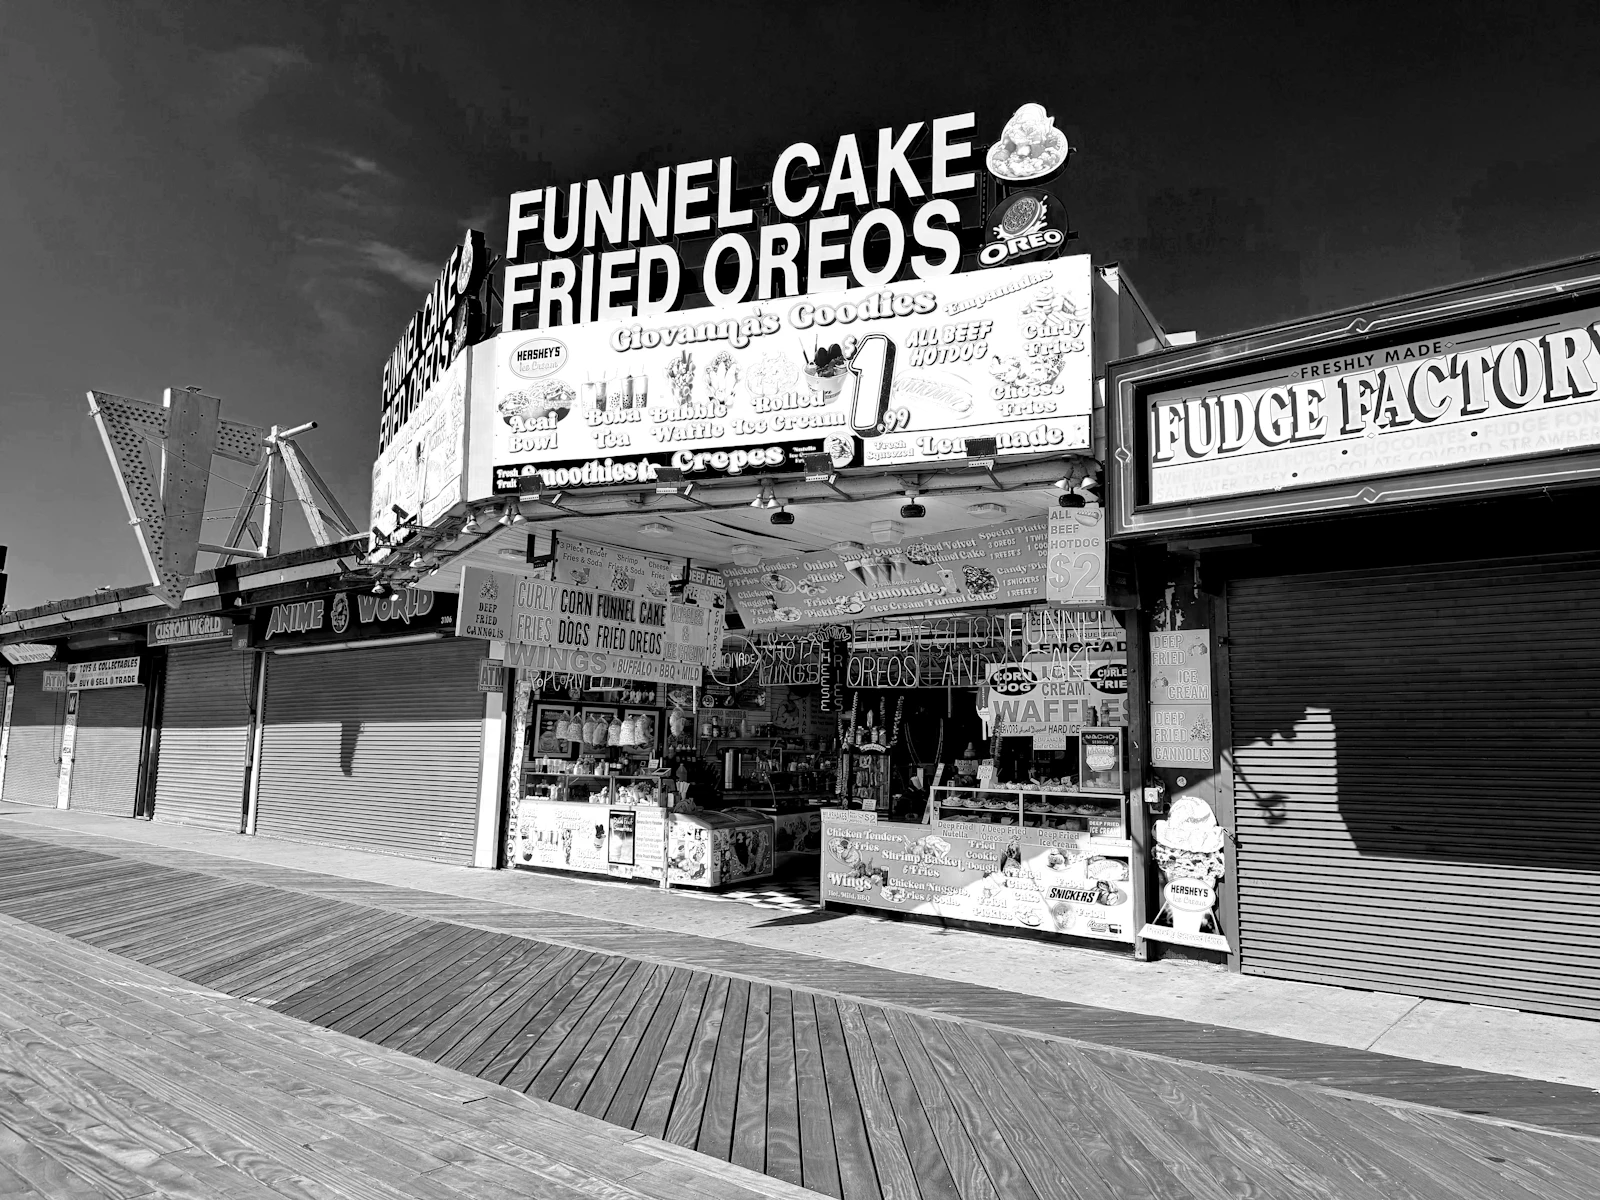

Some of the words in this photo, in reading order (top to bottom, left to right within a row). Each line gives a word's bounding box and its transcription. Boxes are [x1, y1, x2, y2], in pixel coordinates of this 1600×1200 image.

[506, 155, 754, 258] FUNNEL
[771, 112, 975, 218] CAKE
[978, 229, 1063, 267] OREO
[502, 244, 681, 332] FRIED
[702, 199, 961, 307] OREOS
[421, 245, 458, 351] CAKE
[944, 269, 1053, 317] Empanadas
[610, 306, 781, 353] Giovanna's
[788, 290, 938, 330] Goodies
[906, 327, 940, 349] ALL
[941, 319, 993, 344] BEEF
[1021, 320, 1086, 340] Curly
[516, 345, 562, 362] HERSHEY'S
[909, 341, 989, 368] HOTDOG
[1022, 337, 1086, 358] Fries
[1301, 354, 1375, 379] FRESHLY
[1385, 341, 1443, 364] MADE
[989, 380, 1065, 402] Cheese
[1152, 380, 1329, 464] FUDGE
[1340, 320, 1600, 436] FACTOR
[751, 389, 826, 415] Rolled
[998, 399, 1058, 419] Fries
[584, 408, 642, 427] Boba
[650, 402, 728, 424] Bubble
[509, 411, 559, 435] Acai
[731, 416, 769, 436] Ice
[769, 411, 847, 433] Cream
[1484, 414, 1549, 439] FUDGE
[592, 429, 632, 451] Tea
[650, 421, 726, 443] Waffle
[508, 432, 559, 454] Bowl
[915, 425, 1065, 456] Lemnade
[671, 446, 786, 475] Crepes
[1050, 510, 1072, 520] ALL
[978, 527, 1015, 541] Special
[1050, 523, 1080, 535] BEEF
[565, 543, 584, 553] Piece
[585, 546, 608, 558] Tender
[943, 537, 977, 551] Velvet
[993, 538, 1016, 549] OREOS
[1050, 537, 1100, 549] HOTDOG
[562, 552, 579, 562] Fries
[586, 557, 603, 567] Soda
[616, 553, 639, 566] Shrimp
[958, 548, 987, 560] Cake
[607, 562, 622, 571] Fries
[630, 566, 645, 576] Soda
[648, 560, 670, 571] Cheese
[722, 567, 759, 578] Chicken
[758, 561, 798, 574] Tenders
[803, 560, 839, 572] Onion
[996, 563, 1028, 576] Candy
[651, 571, 665, 580] Fries
[804, 571, 845, 584] Rings
[1007, 575, 1040, 587] SNICKERS
[1047, 550, 1102, 598] $2
[517, 581, 558, 611] CURLY
[854, 580, 942, 603] Lemonade
[479, 602, 498, 613] DEEP
[560, 588, 593, 616] CORN
[803, 597, 836, 608] Fried
[870, 604, 888, 614] Ice
[888, 600, 924, 611] Cream
[924, 594, 967, 607] Funnel
[966, 591, 998, 603] Cake
[265, 600, 324, 640] ANIME
[357, 587, 434, 625] WORLD
[597, 594, 636, 623] FUNNEL
[640, 601, 667, 627] CAKE
[155, 621, 190, 640] CUSTOM
[189, 616, 221, 636] WORLD
[516, 613, 553, 642] FRIES
[558, 620, 590, 647] DOGS
[1009, 609, 1118, 648] FUNNEL
[596, 625, 626, 650] FRIED
[629, 630, 662, 655] OREOS
[1153, 634, 1184, 650] DEEP
[508, 643, 607, 675] WINGS
[617, 658, 653, 677] BUFFALO
[659, 664, 676, 680] BBQ
[681, 667, 700, 681] MILD
[1021, 645, 1102, 683] CAKE
[1151, 651, 1187, 666] FRIED
[79, 664, 92, 673] TOYS
[847, 655, 917, 687] OREOS
[993, 671, 1032, 682] CORN
[44, 674, 66, 688] ATM
[79, 678, 90, 688] BUY
[95, 677, 109, 686] SELL
[114, 675, 136, 684] TRADE
[1177, 669, 1199, 685] ICE
[997, 682, 1031, 693] DOG
[1041, 682, 1085, 697] CREAM
[1167, 685, 1210, 701] CREAM
[1154, 711, 1186, 727] DEEP
[1048, 724, 1067, 734] HARD
[1153, 727, 1188, 743] FRIED
[1153, 745, 1211, 763] CANNOLIS
[937, 821, 955, 831] Deep
[956, 822, 974, 831] Fried
[942, 829, 968, 838] Nutella
[987, 824, 1006, 835] Deep
[1007, 826, 1028, 836] Fried
[826, 827, 862, 840] Chicken
[864, 829, 903, 843] Tenders
[1038, 829, 1058, 840] Deep
[1058, 831, 1080, 841] Fried
[853, 840, 880, 852] Fries
[968, 840, 996, 851] Fried
[1039, 838, 1051, 847] Ice
[1051, 839, 1079, 849] Cream
[881, 850, 921, 864] Shrimp
[965, 850, 999, 862] Cookie
[910, 865, 941, 878] Fries
[966, 859, 999, 874] Dough
[827, 871, 873, 892] Wings
[888, 877, 926, 891] Chicken
[1049, 887, 1096, 904] SNICKERS
[1170, 883, 1210, 899] HERSHEY'S
